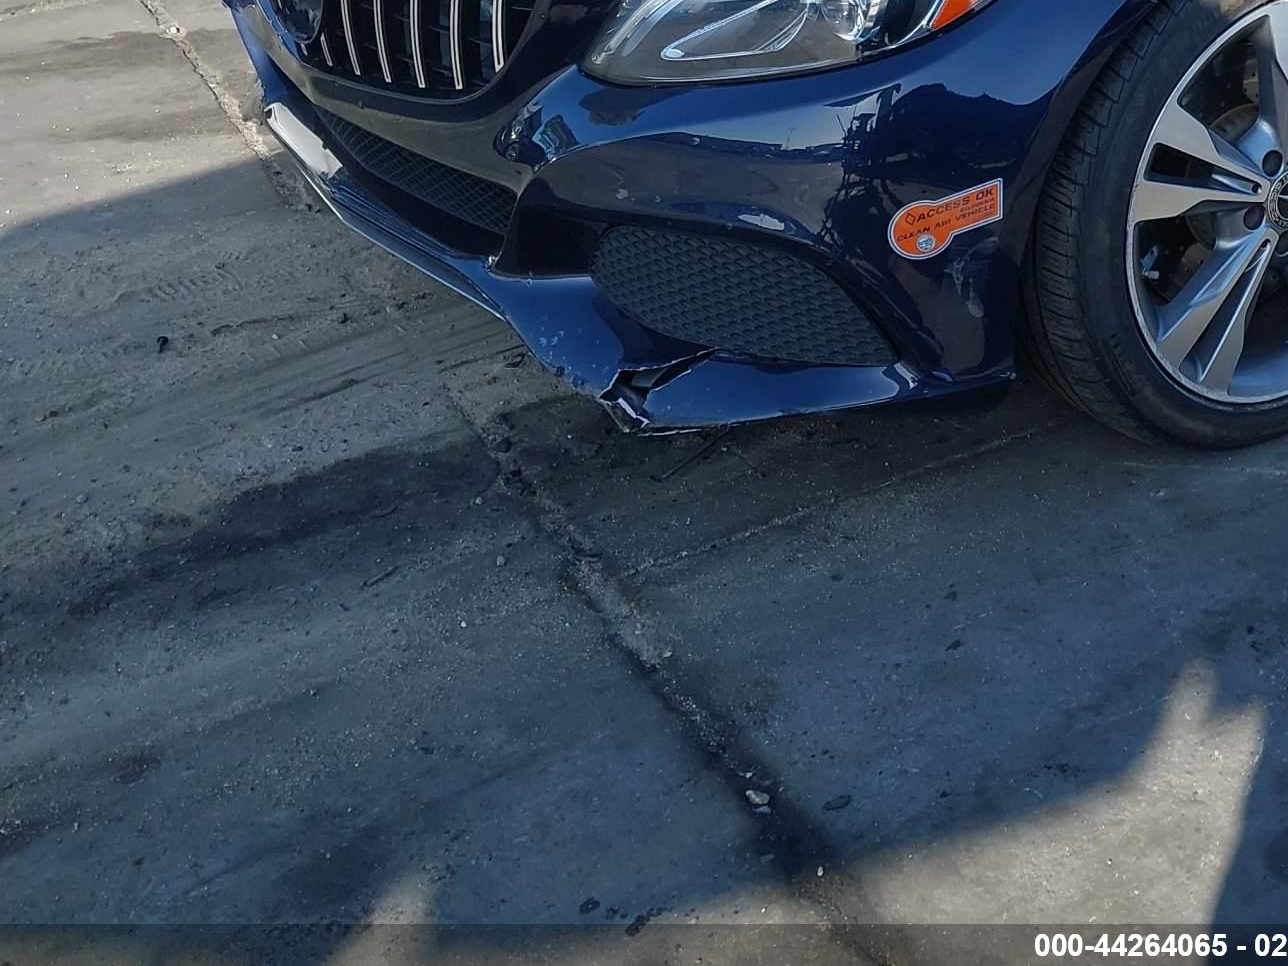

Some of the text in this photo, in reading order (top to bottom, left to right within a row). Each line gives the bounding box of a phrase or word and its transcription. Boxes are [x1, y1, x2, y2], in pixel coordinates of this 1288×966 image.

[916, 196, 970, 223] ACCESS
[975, 188, 994, 200] OK
[896, 225, 931, 242] CLEAN
